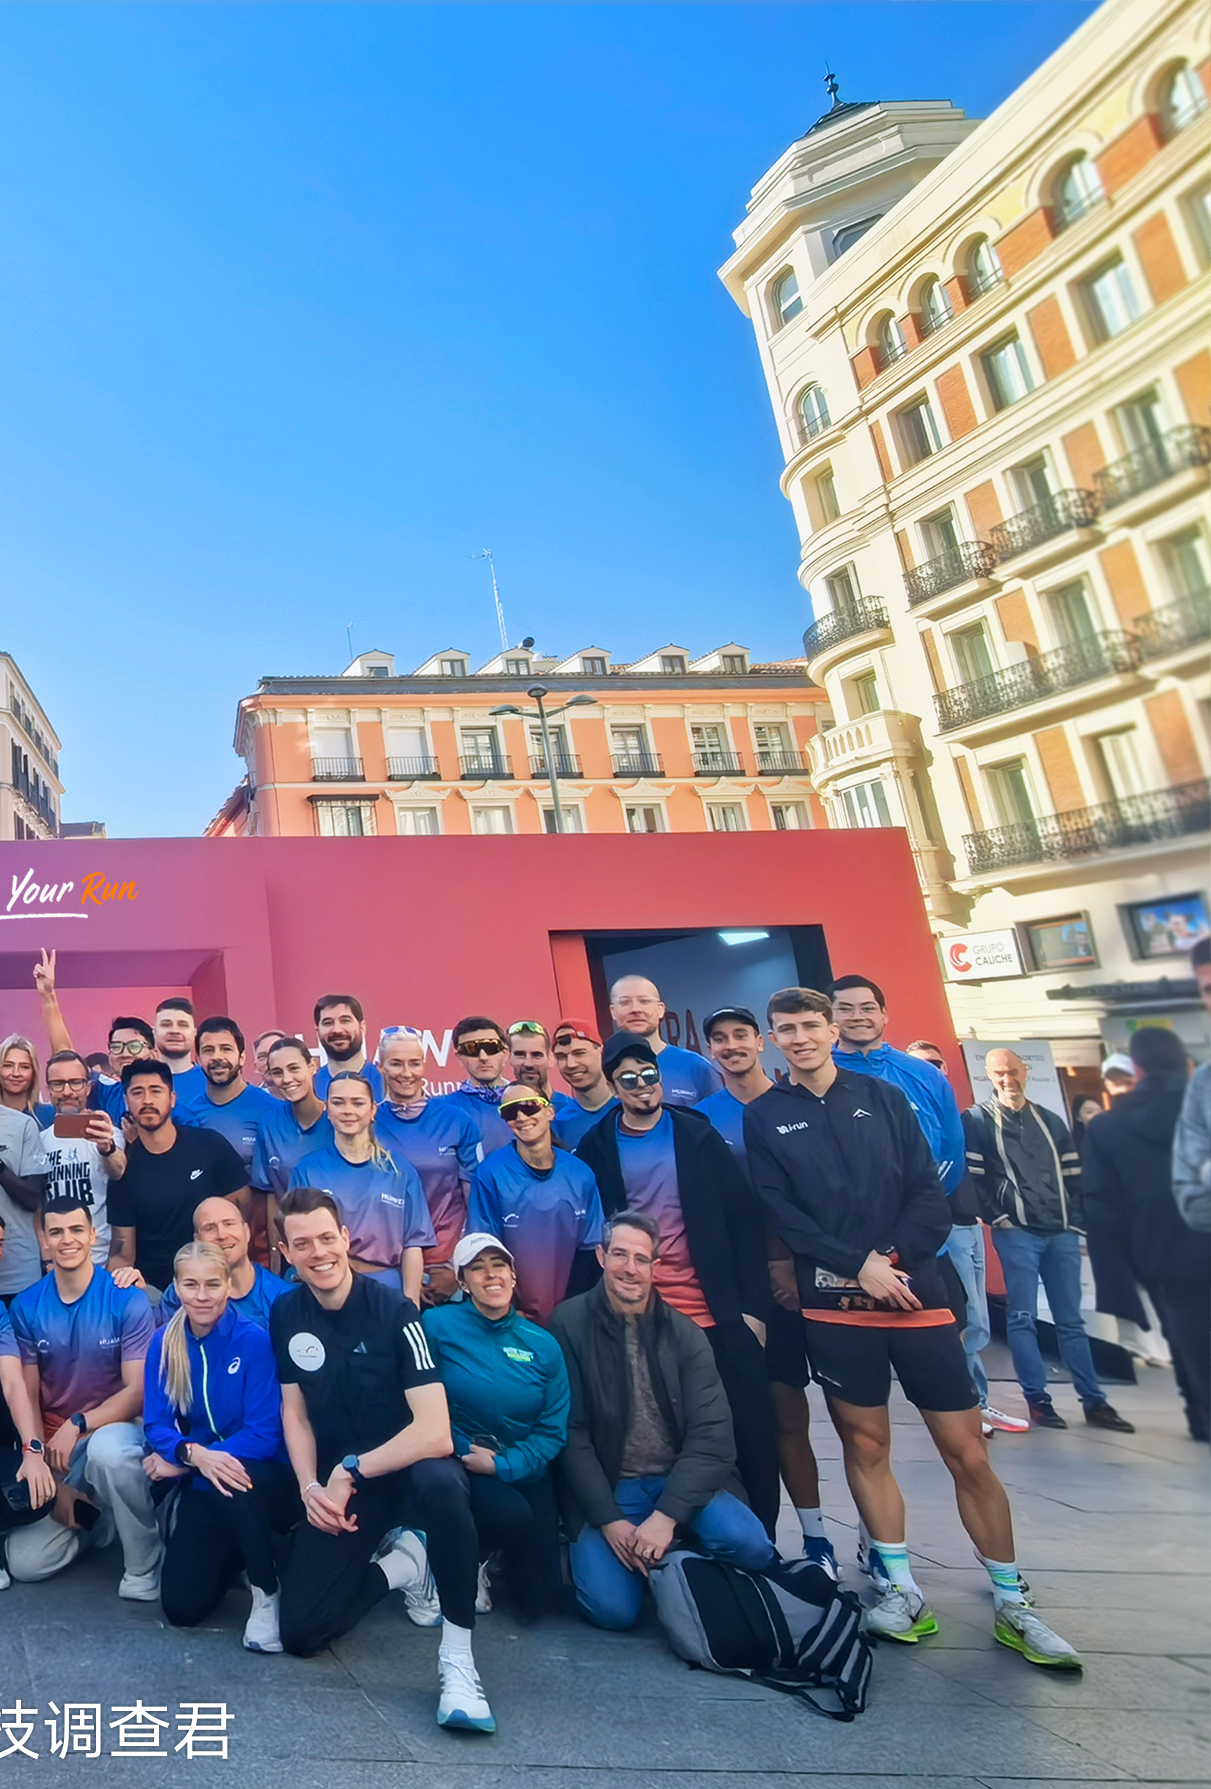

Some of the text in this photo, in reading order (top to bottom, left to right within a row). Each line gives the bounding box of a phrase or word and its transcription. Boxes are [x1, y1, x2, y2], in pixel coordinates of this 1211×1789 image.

[6, 868, 74, 912] Your
[80, 871, 139, 905] Run
[972, 943, 1004, 955] GRUPO
[975, 953, 1013, 966] CALICHE
[46, 1149, 62, 1167] HE
[48, 1161, 91, 1182] UNNING
